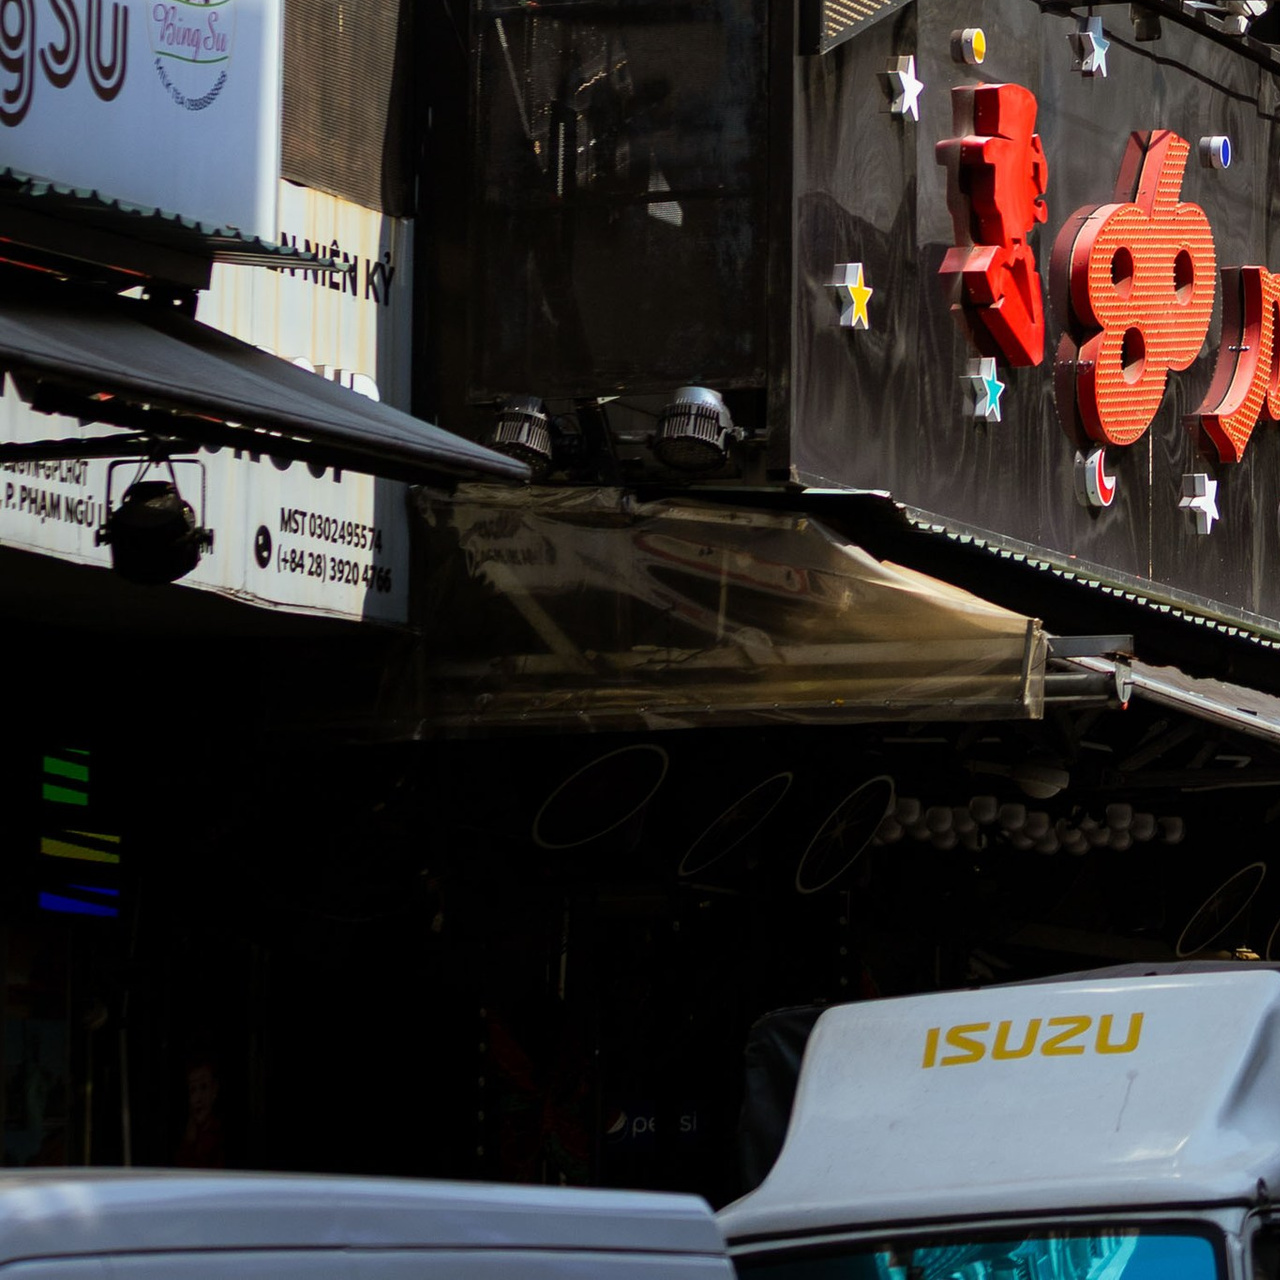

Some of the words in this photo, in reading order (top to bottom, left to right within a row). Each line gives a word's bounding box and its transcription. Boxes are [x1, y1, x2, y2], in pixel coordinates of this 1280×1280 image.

[365, 250, 395, 307] KỶ
[19, 485, 62, 524] PHẠM
[280, 507, 307, 535] MST
[277, 544, 305, 574] (+84
[307, 552, 327, 583] 28)
[329, 557, 360, 586] 3920
[922, 1012, 1144, 1068] ISUZU
[632, 1110, 698, 1139] pesi
